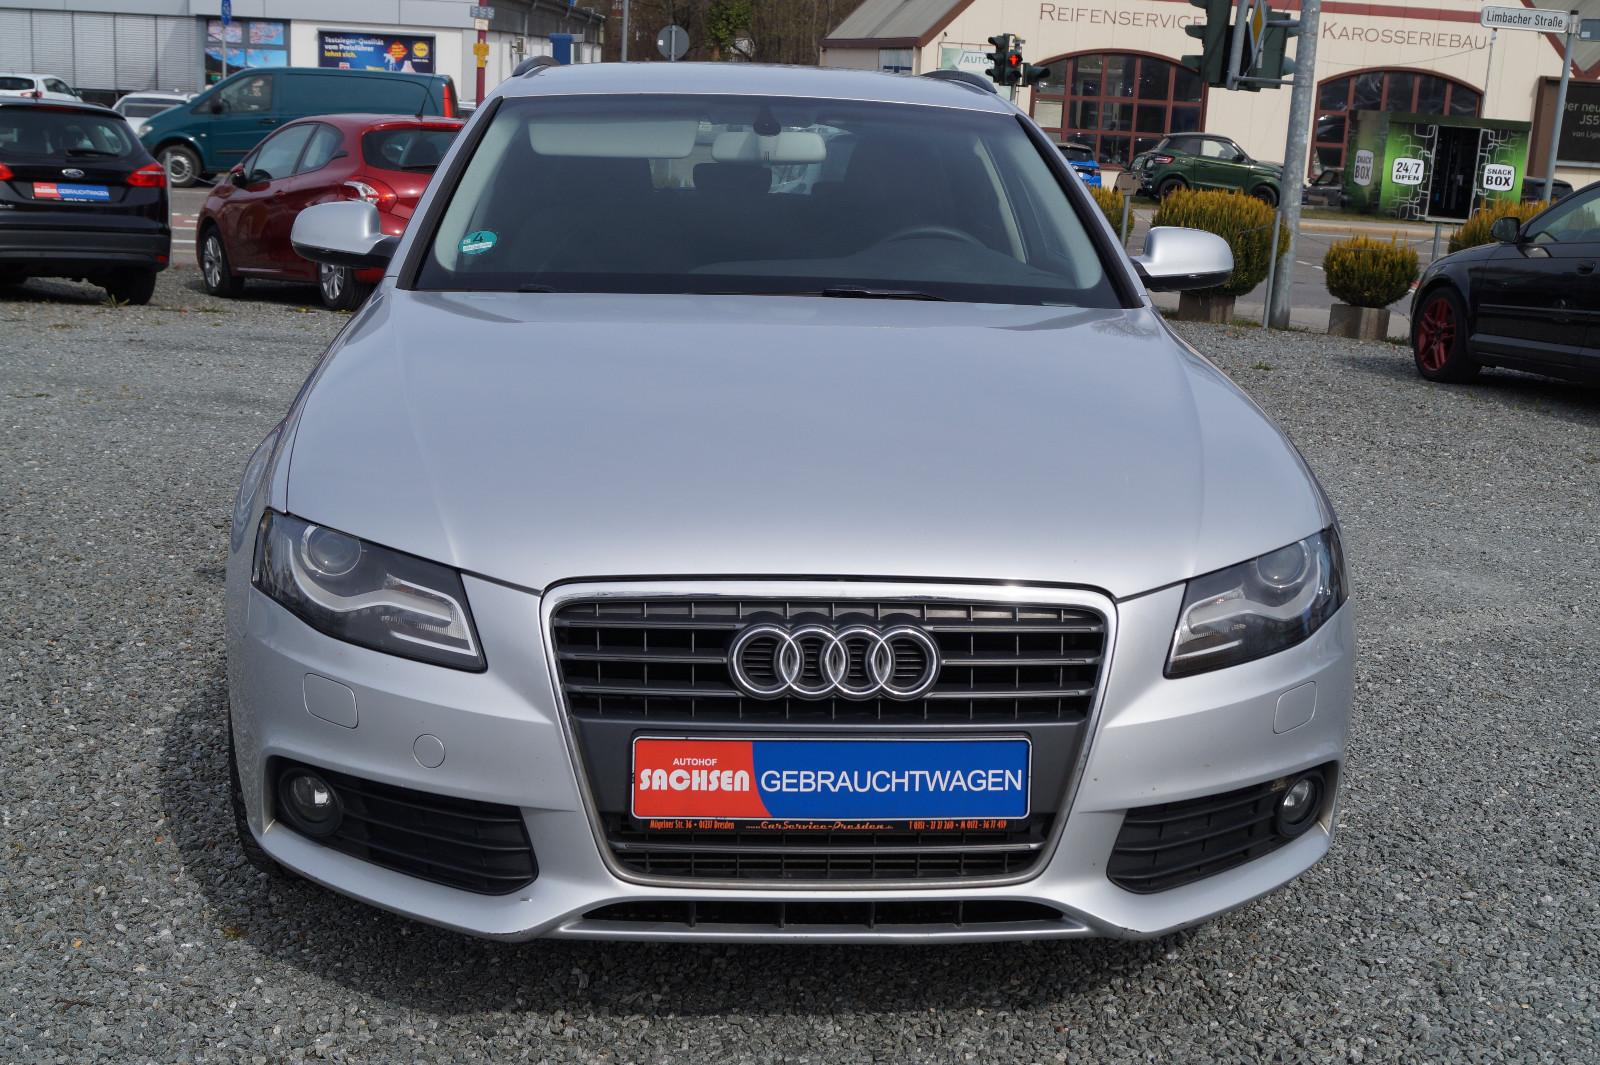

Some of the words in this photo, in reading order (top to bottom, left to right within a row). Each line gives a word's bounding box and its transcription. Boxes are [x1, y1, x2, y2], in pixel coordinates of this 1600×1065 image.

[1486, 10, 1531, 26] Limbacher
[1534, 14, 1563, 28] Straße
[1321, 21, 1487, 50] KAROSSERIEBAU
[1354, 165, 1371, 180] BOX
[1395, 161, 1421, 174] 24/7
[1487, 167, 1512, 176] SNACK
[1485, 176, 1511, 187] BOX
[672, 757, 718, 767] AUTOHOF
[639, 768, 750, 792] SACHSEN
[760, 769, 1023, 793] GEBRAUCHTWAGEN
[714, 820, 735, 830] Dresden
